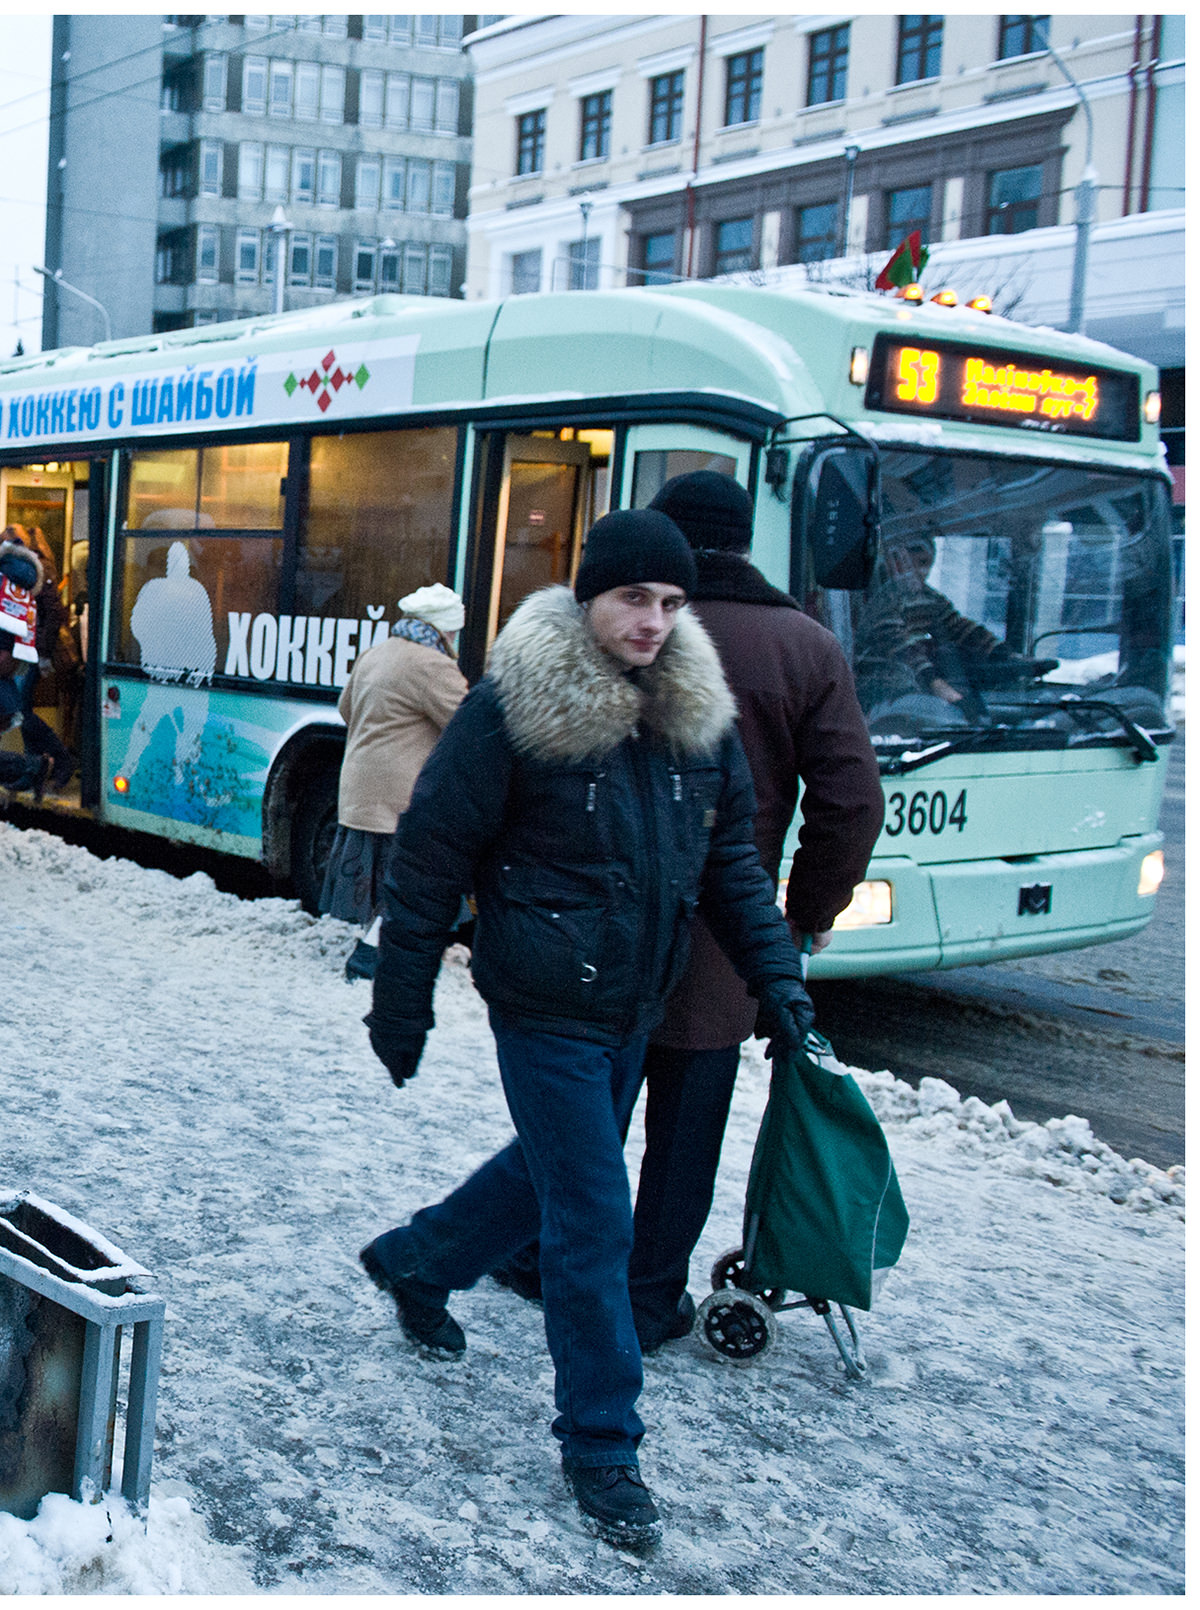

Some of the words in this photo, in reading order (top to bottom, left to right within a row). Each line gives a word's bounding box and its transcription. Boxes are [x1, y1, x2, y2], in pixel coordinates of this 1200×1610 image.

[7, 386, 102, 439] ХОККЕЮ
[108, 381, 125, 429] С
[131, 355, 258, 427] ШАЙБОЙ
[897, 347, 940, 403] 53
[224, 605, 390, 687] ХОККЕЙ
[885, 789, 968, 837] 3604
